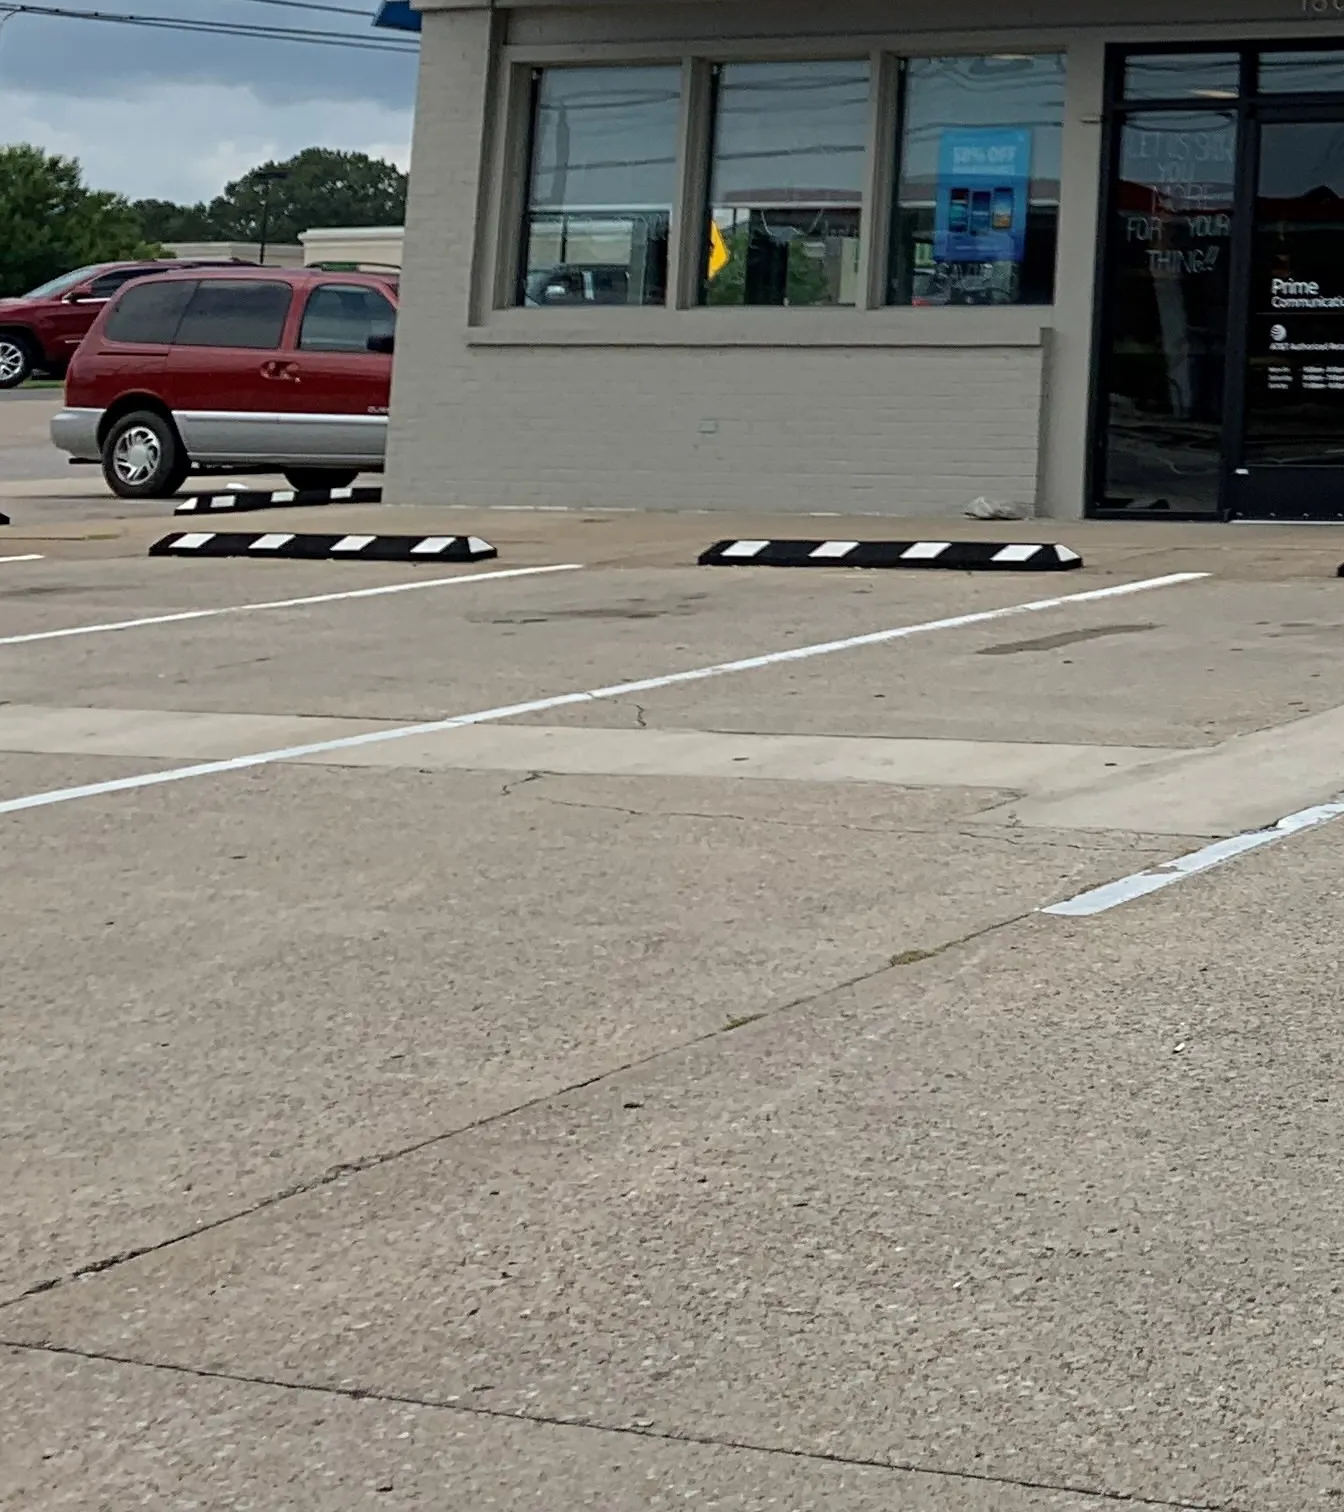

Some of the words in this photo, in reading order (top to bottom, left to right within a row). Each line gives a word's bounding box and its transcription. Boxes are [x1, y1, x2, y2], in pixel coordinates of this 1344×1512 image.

[1126, 215, 1164, 242] FOR
[1186, 214, 1231, 238] YOUR
[1271, 278, 1319, 295] Prime
